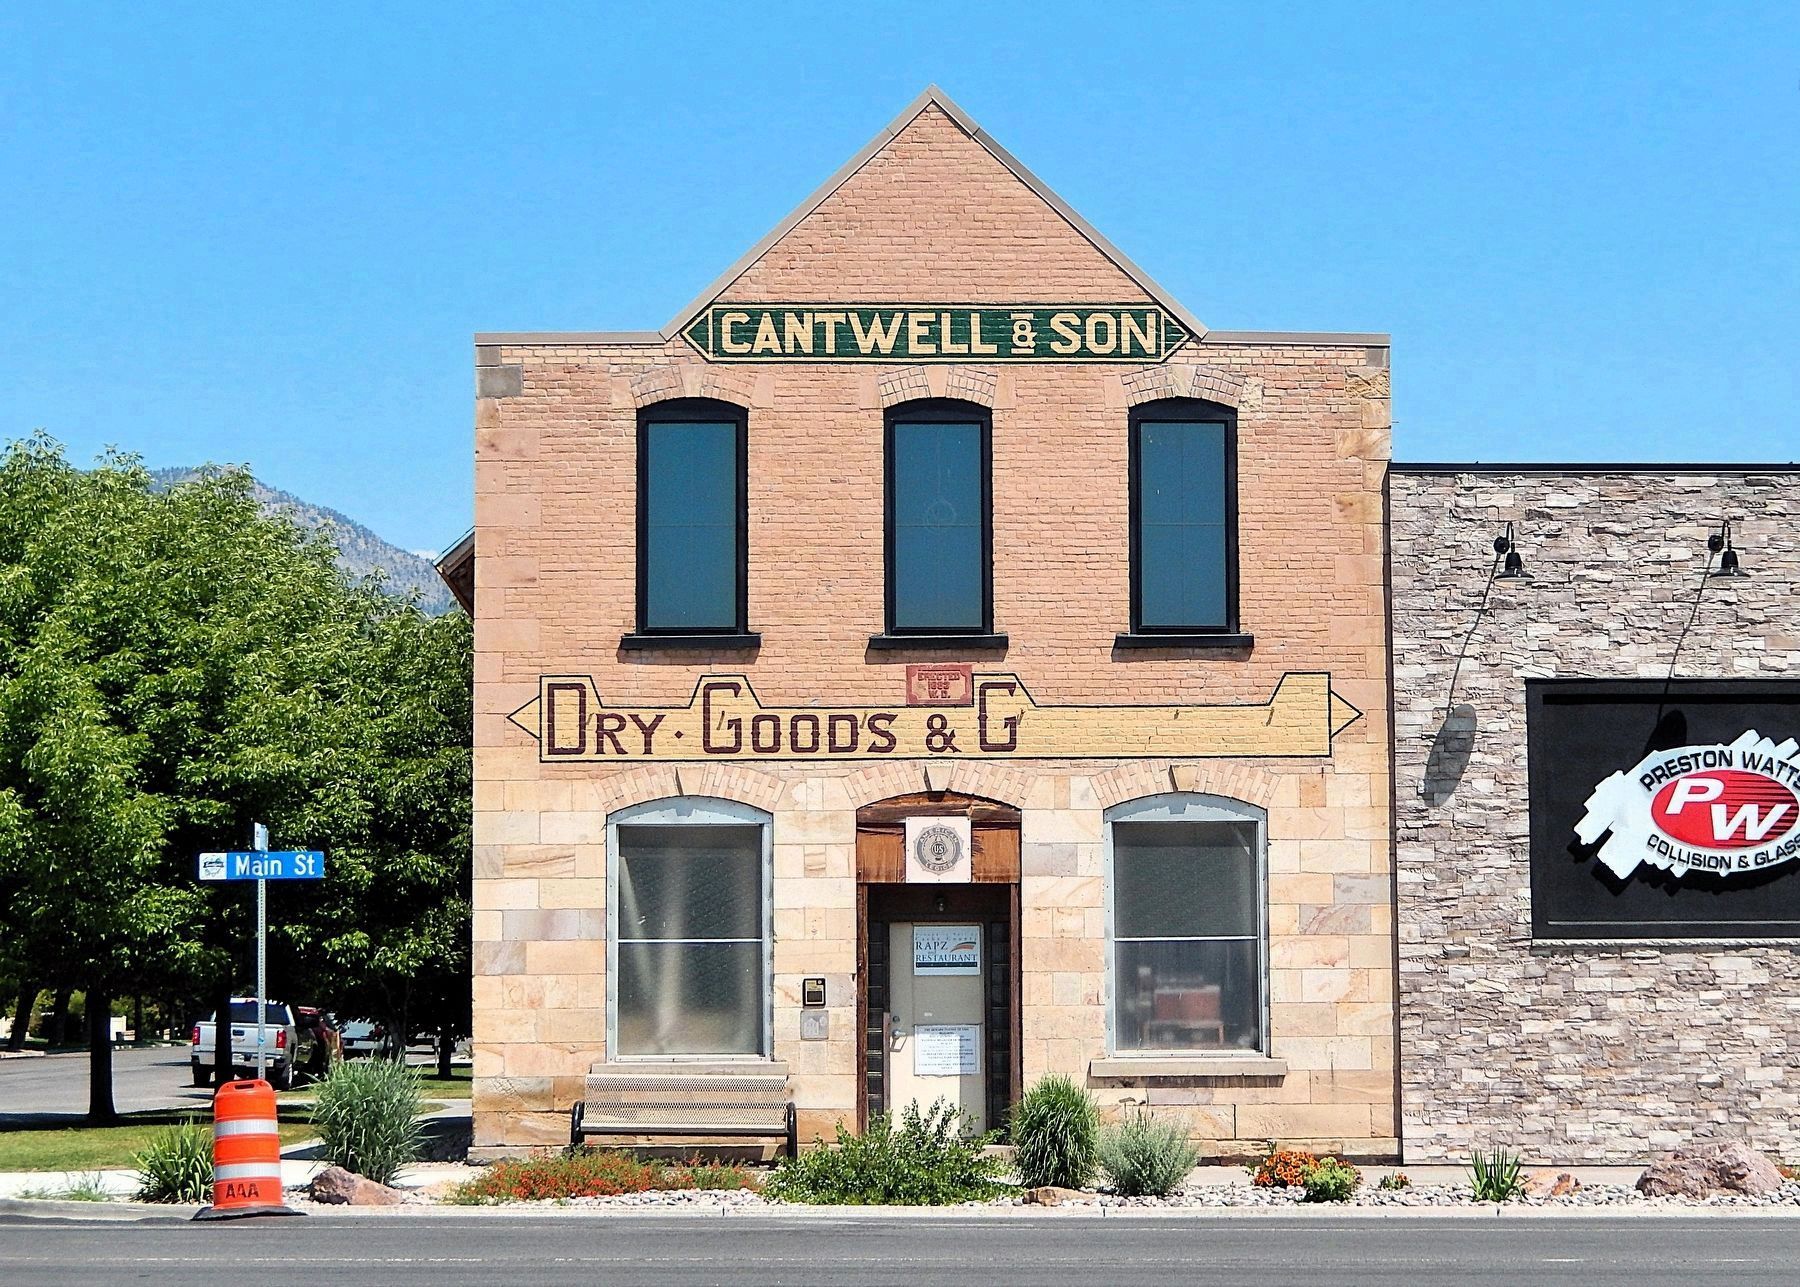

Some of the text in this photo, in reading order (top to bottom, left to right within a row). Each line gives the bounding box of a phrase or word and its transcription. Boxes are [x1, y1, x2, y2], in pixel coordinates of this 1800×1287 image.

[720, 311, 1157, 355] CANTWELL & SON
[546, 681, 1018, 755] DRY GOODS & G
[1639, 749, 1733, 792] PRESTON
[235, 853, 315, 877] Main St
[1647, 833, 1732, 869] COLLISION
[1737, 854, 1750, 869] &
[916, 941, 948, 951] RAPZ
[916, 954, 977, 962] RESTAURANT
[225, 1182, 259, 1199] AAA
